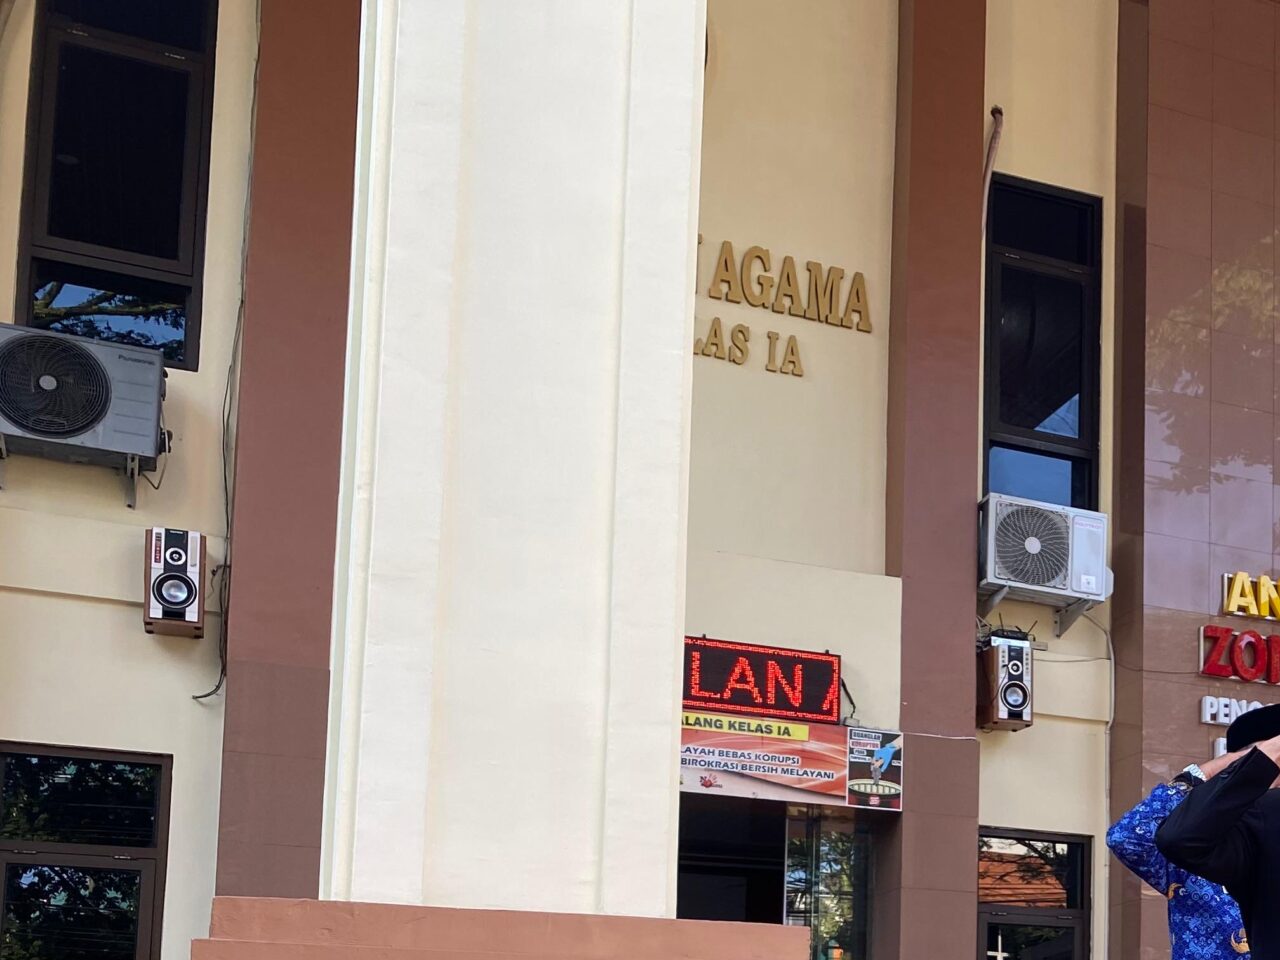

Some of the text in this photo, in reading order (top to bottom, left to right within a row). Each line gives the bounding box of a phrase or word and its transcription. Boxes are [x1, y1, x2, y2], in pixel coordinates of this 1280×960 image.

[708, 240, 872, 333] AGAMA
[766, 331, 803, 377] IA
[690, 650, 803, 707] LAN
[728, 720, 773, 735] KELAS
[777, 725, 791, 736] IA
[681, 757, 835, 779] BIROKRASI BERSIH MELAYANI
[718, 749, 752, 760] BEBAS
[755, 753, 800, 765] KORUPSI
